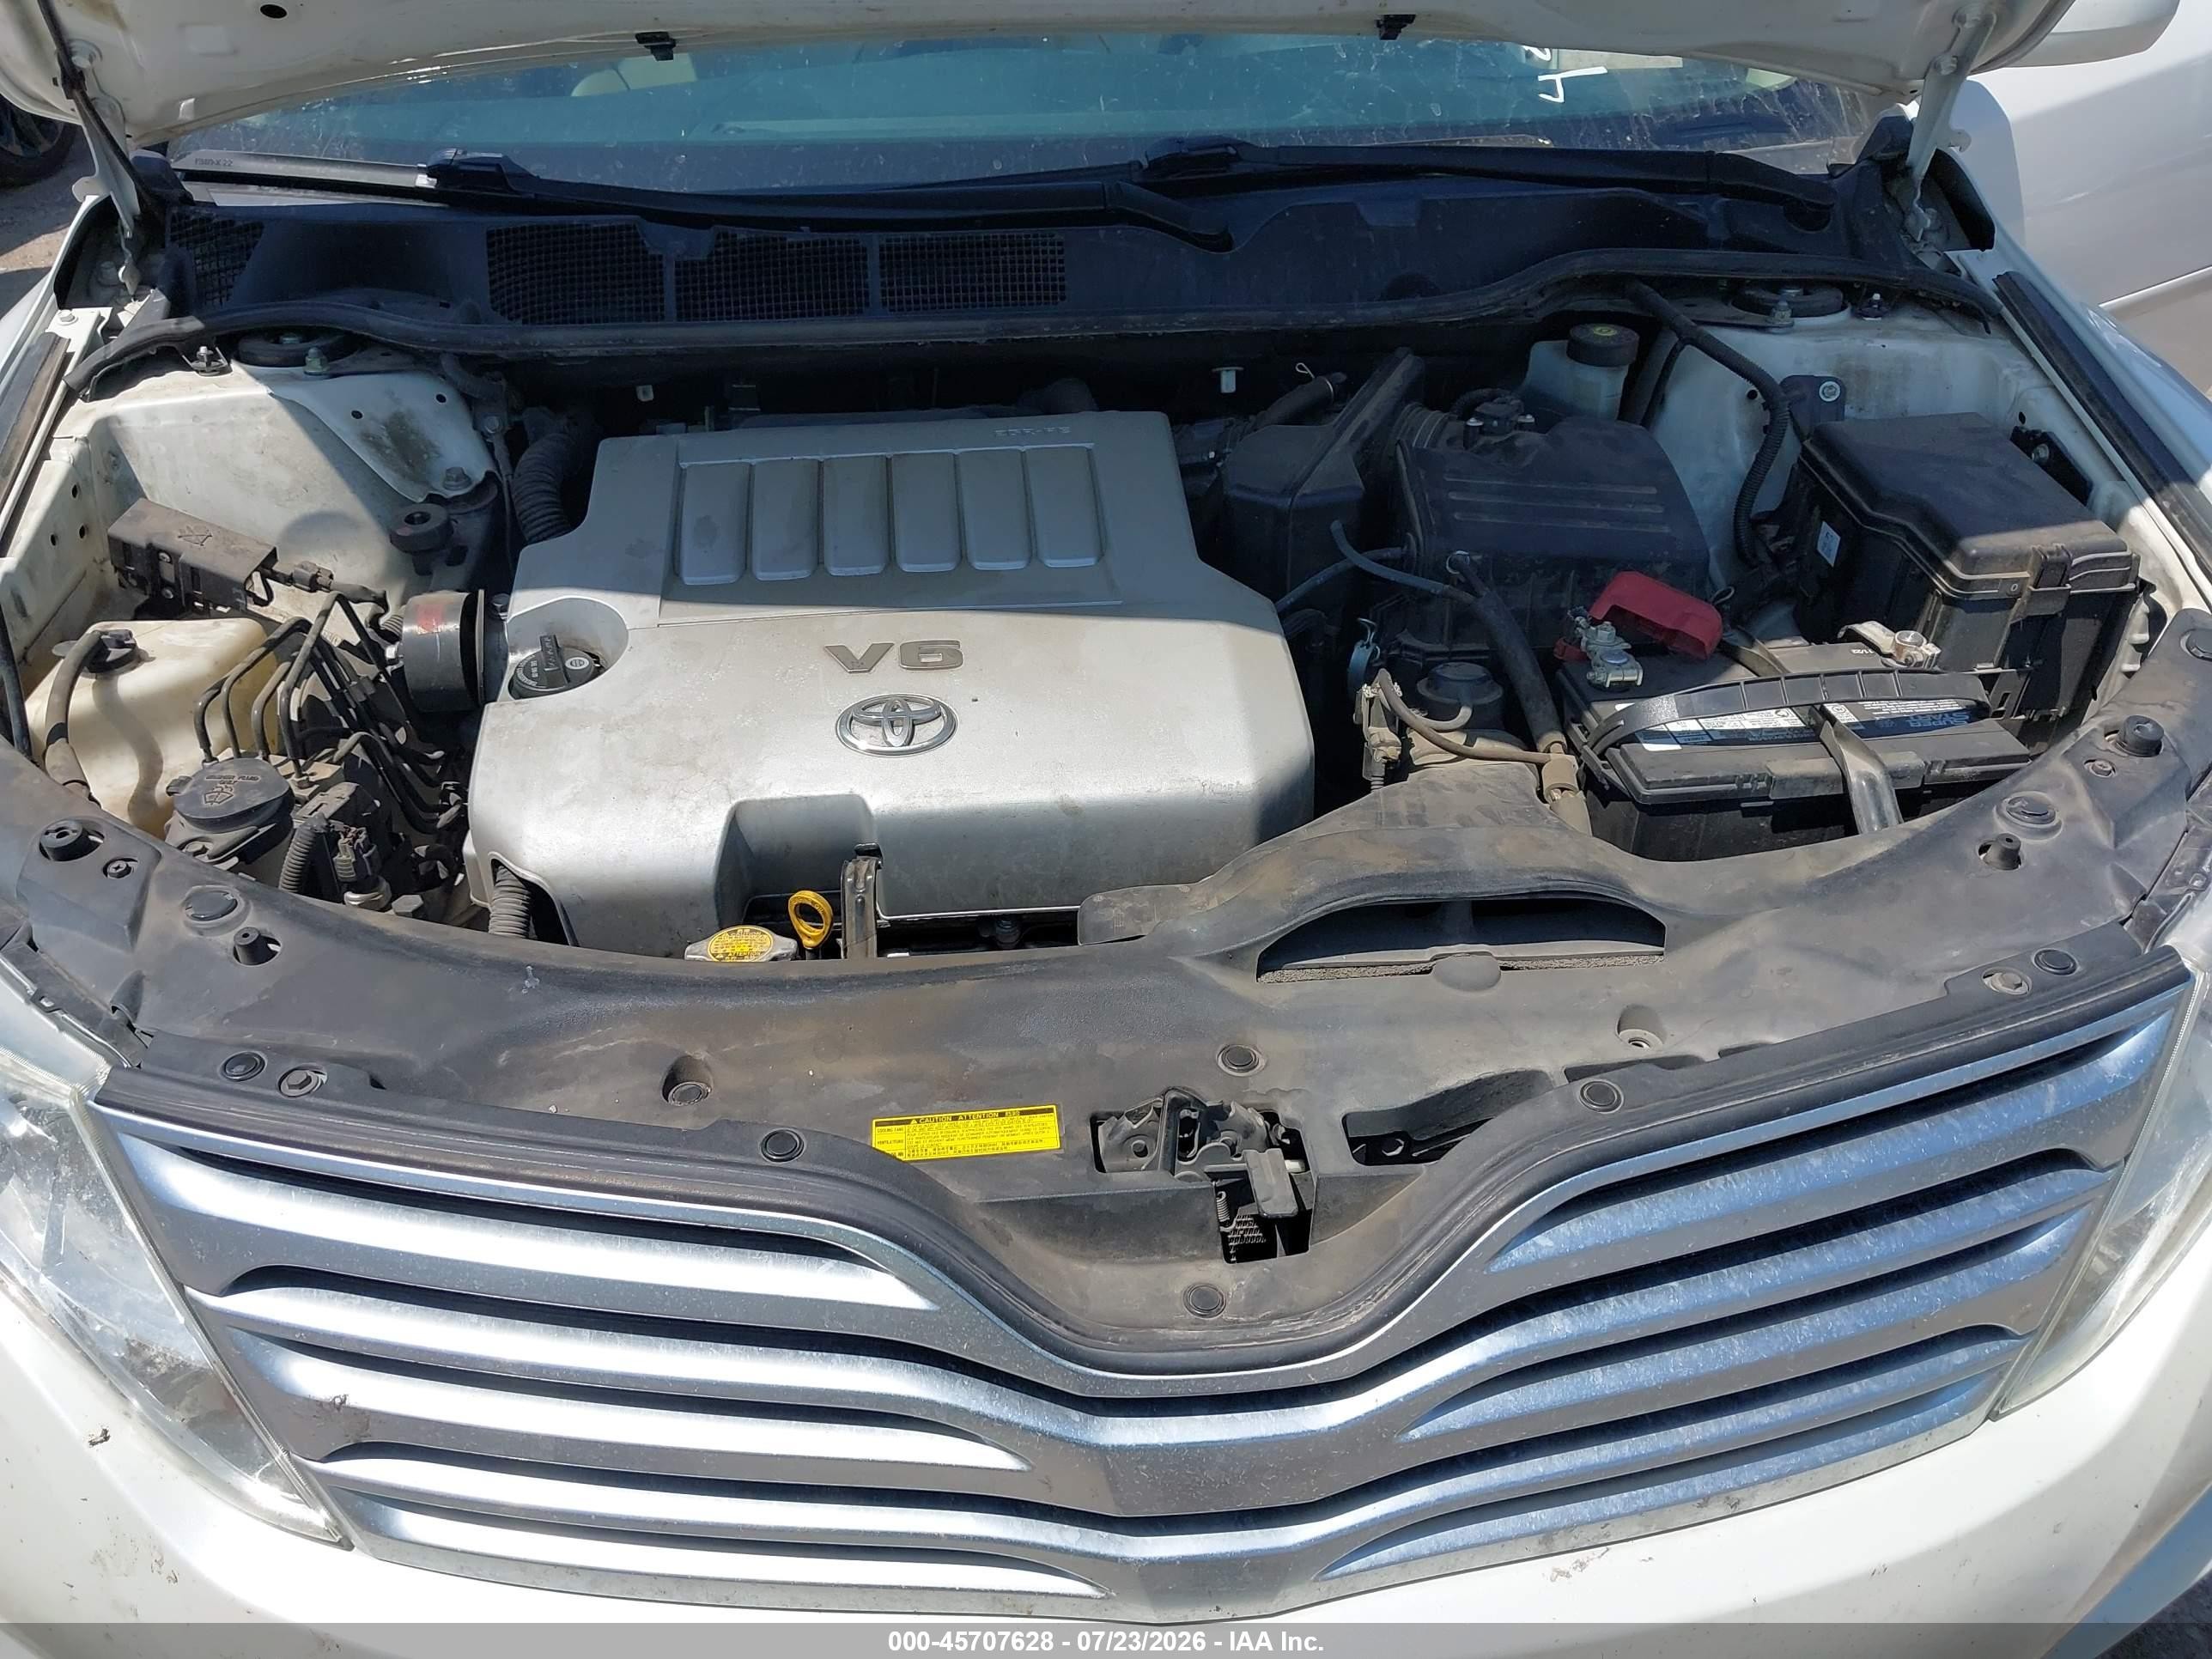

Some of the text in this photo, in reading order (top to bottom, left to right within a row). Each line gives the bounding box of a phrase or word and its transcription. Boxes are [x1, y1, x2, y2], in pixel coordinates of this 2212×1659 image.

[824, 640, 963, 673] V6
[1906, 718, 1968, 728] SUPER
[919, 1115, 952, 1124] CAUTION
[957, 1111, 999, 1121] ATTENTION
